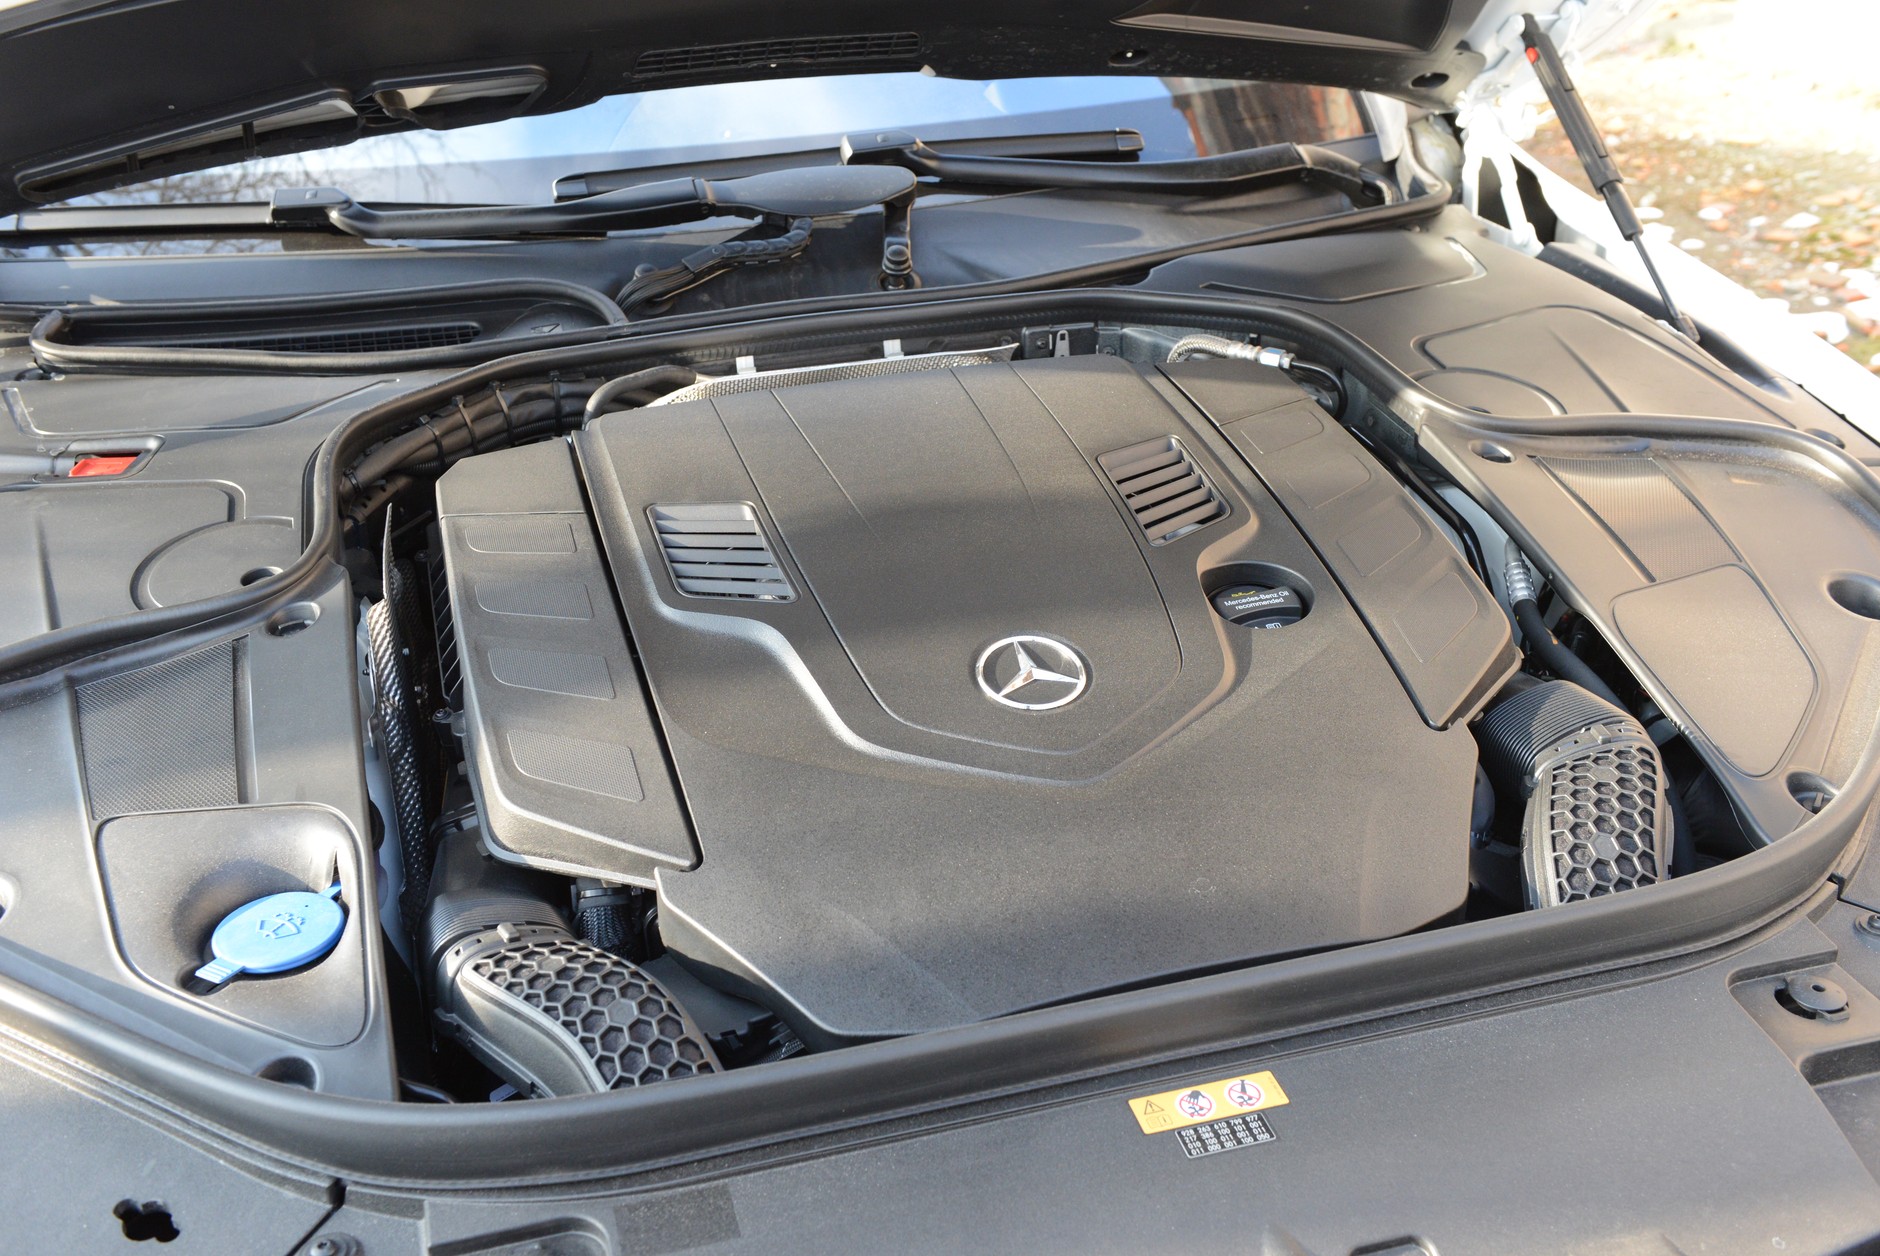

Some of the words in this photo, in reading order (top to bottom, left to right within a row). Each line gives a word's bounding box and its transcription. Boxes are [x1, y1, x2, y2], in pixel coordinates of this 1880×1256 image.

[1224, 593, 1278, 606] Mercedes-Benz
[1236, 597, 1284, 610] recommended
[1214, 1122, 1227, 1130] 610
[1185, 1135, 1196, 1143] 217
[1234, 1124, 1246, 1132] 101
[1220, 1134, 1233, 1142] 011
